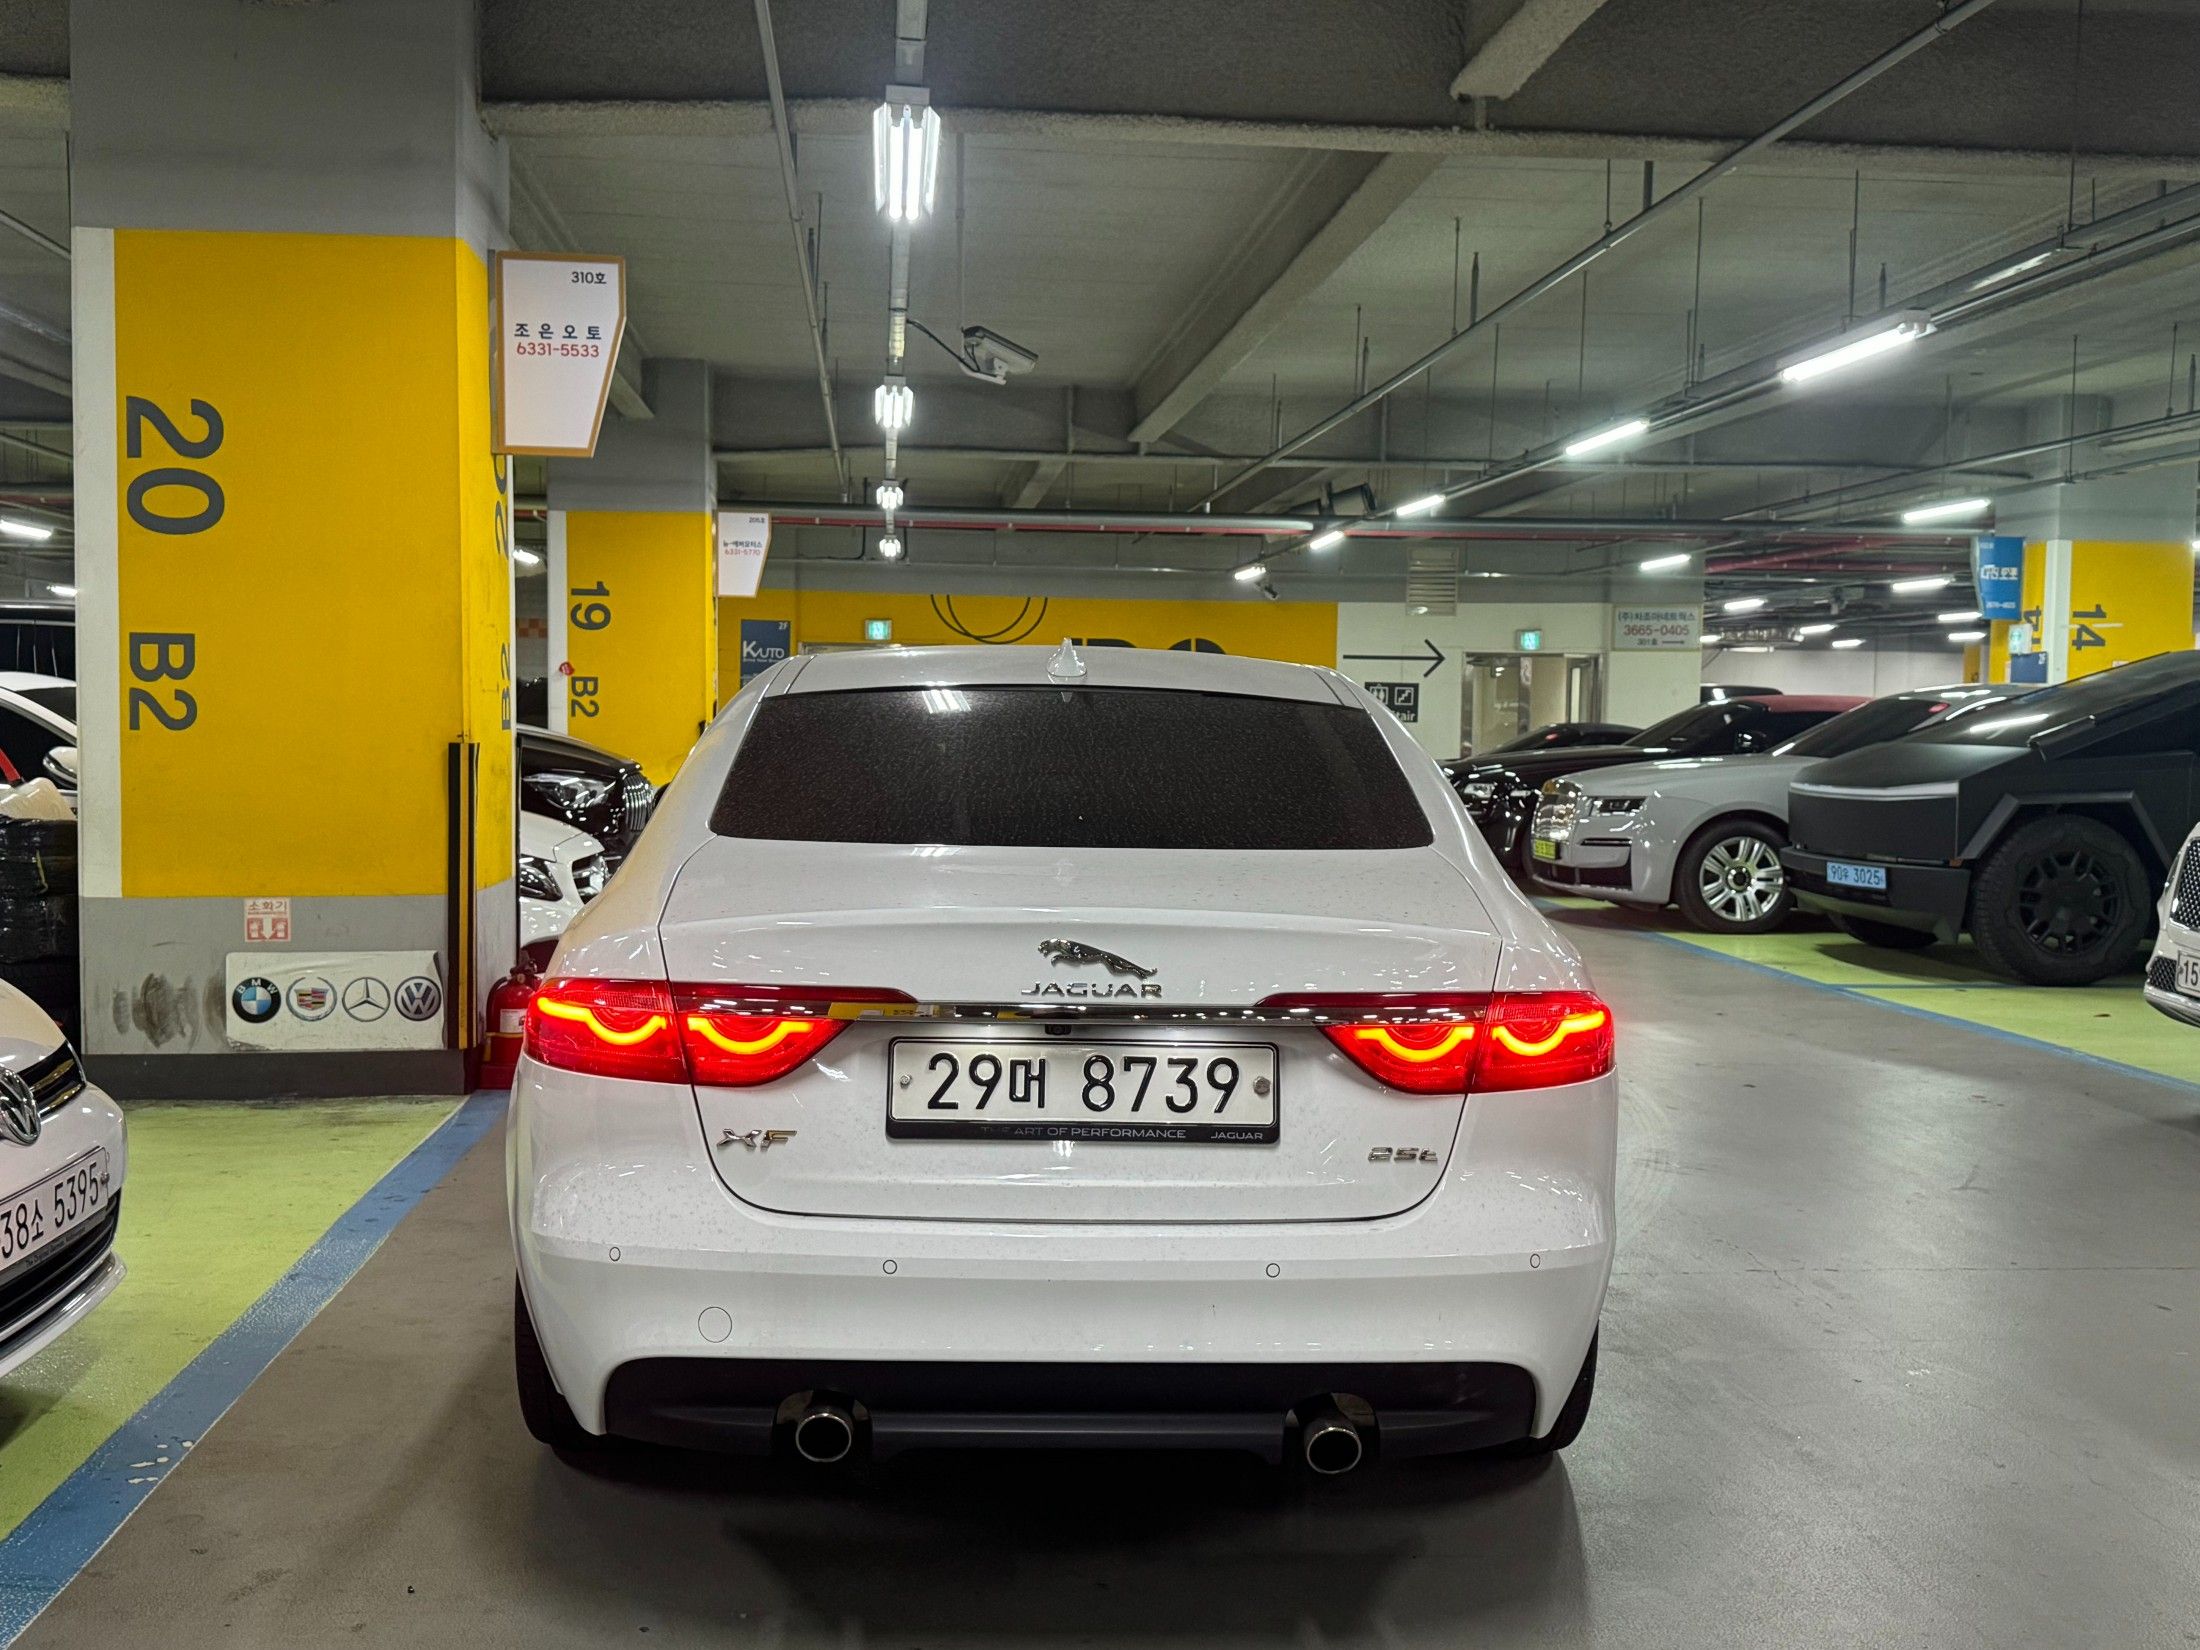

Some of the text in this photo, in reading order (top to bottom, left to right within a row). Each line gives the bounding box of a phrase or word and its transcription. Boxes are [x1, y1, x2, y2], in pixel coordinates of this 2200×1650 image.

[571, 271, 607, 284] 310호
[516, 342, 600, 358] 6331-5533
[126, 395, 225, 730] 20 B2
[1623, 624, 1689, 636] 3665-0405
[2071, 604, 2107, 650] 14
[570, 581, 612, 718] 19 B2
[1853, 867, 1880, 885] 3025
[247, 900, 288, 911] 소화기
[236, 978, 278, 995] BMW
[1021, 983, 1162, 998] JAGUAR
[927, 1053, 1240, 1114] 29머 8739
[717, 1129, 797, 1148] XF
[1014, 1127, 1044, 1136] ART
[1047, 1127, 1068, 1136] OF
[1071, 1128, 1186, 1139] PERFORMANCE
[1210, 1131, 1263, 1140] JAGUAR
[1368, 1147, 1438, 1161] 25t
[0, 1162, 99, 1258] 38소 5395
